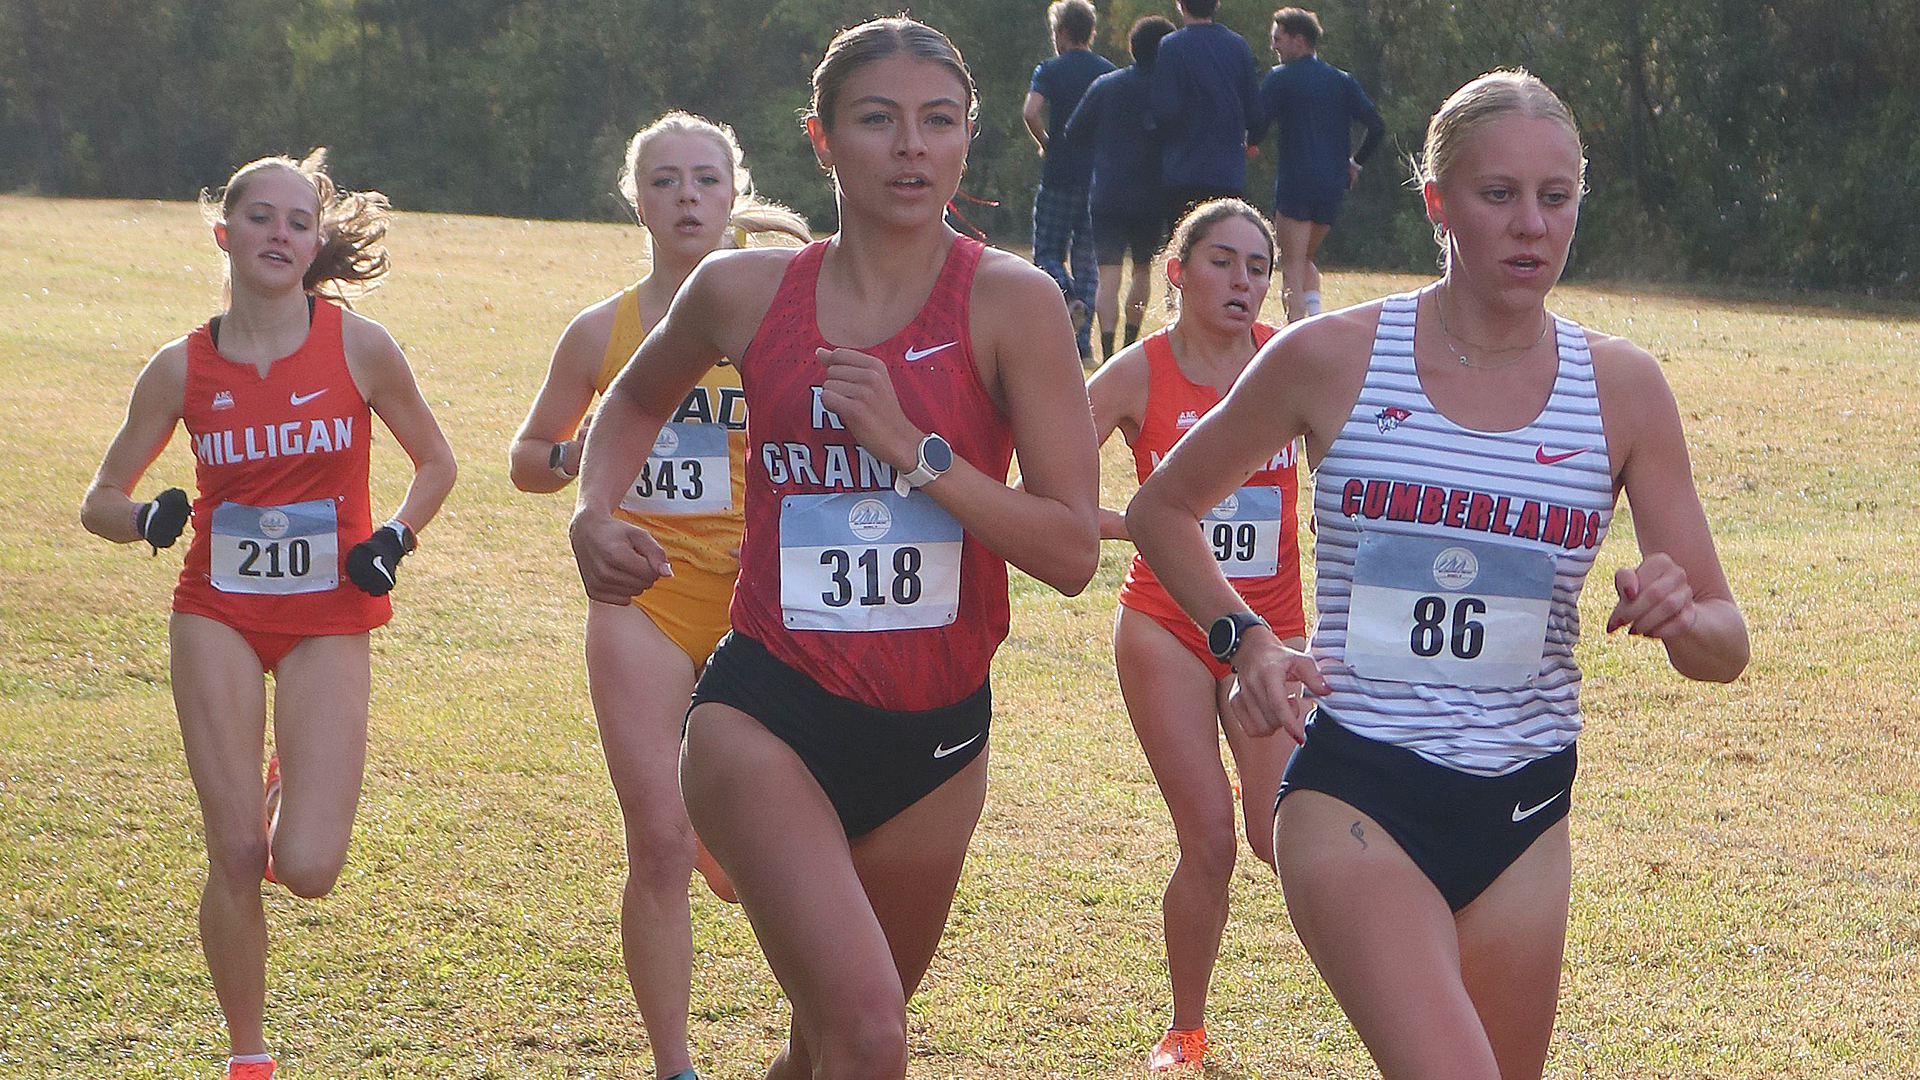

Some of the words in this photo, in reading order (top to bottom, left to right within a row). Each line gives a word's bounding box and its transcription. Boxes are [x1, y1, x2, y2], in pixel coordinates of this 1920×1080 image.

[194, 416, 354, 466] MILLIGAN
[636, 460, 703, 500] 343
[1341, 478, 1601, 550] CUMBERLANDS
[238, 538, 311, 578] 210
[1200, 522, 1256, 562] 99
[820, 546, 922, 607] 318
[1410, 596, 1487, 660] 86
